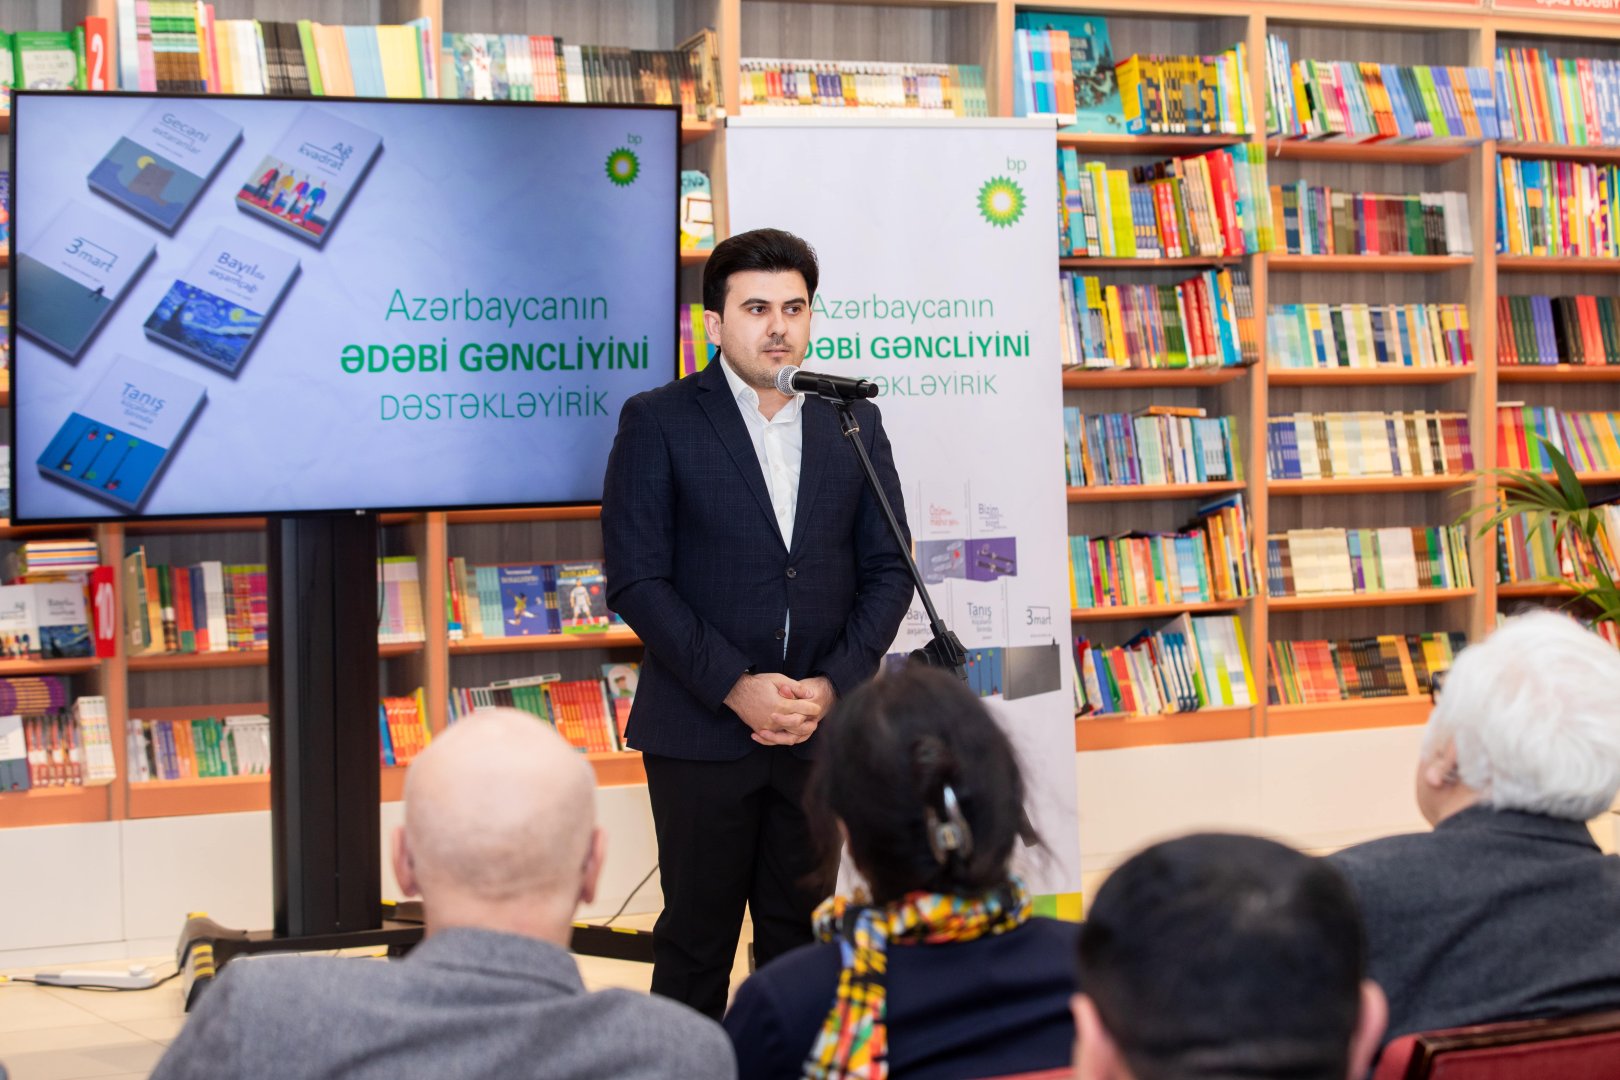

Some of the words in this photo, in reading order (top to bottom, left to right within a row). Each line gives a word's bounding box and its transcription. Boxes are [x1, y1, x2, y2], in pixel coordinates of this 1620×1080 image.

[91, 33, 104, 90] 2
[627, 132, 642, 146] bp
[1006, 155, 1027, 174] bp
[64, 238, 83, 255] 3
[78, 250, 113, 272] mart
[385, 288, 608, 328] Azərbaycanın
[811, 293, 994, 324] Azərbaycanın
[341, 337, 447, 373] ƏDƏBİ
[459, 335, 649, 372] GƏNCLİYİNİ
[870, 330, 1030, 359] GƏNCLİYİNİ
[122, 382, 166, 412] Tanış
[380, 385, 609, 420] DƏSTƏKLƏYİRİK
[95, 582, 115, 640] 10
[967, 602, 992, 618] Tanış
[1026, 609, 1034, 625] 3
[1034, 615, 1052, 625] mart
